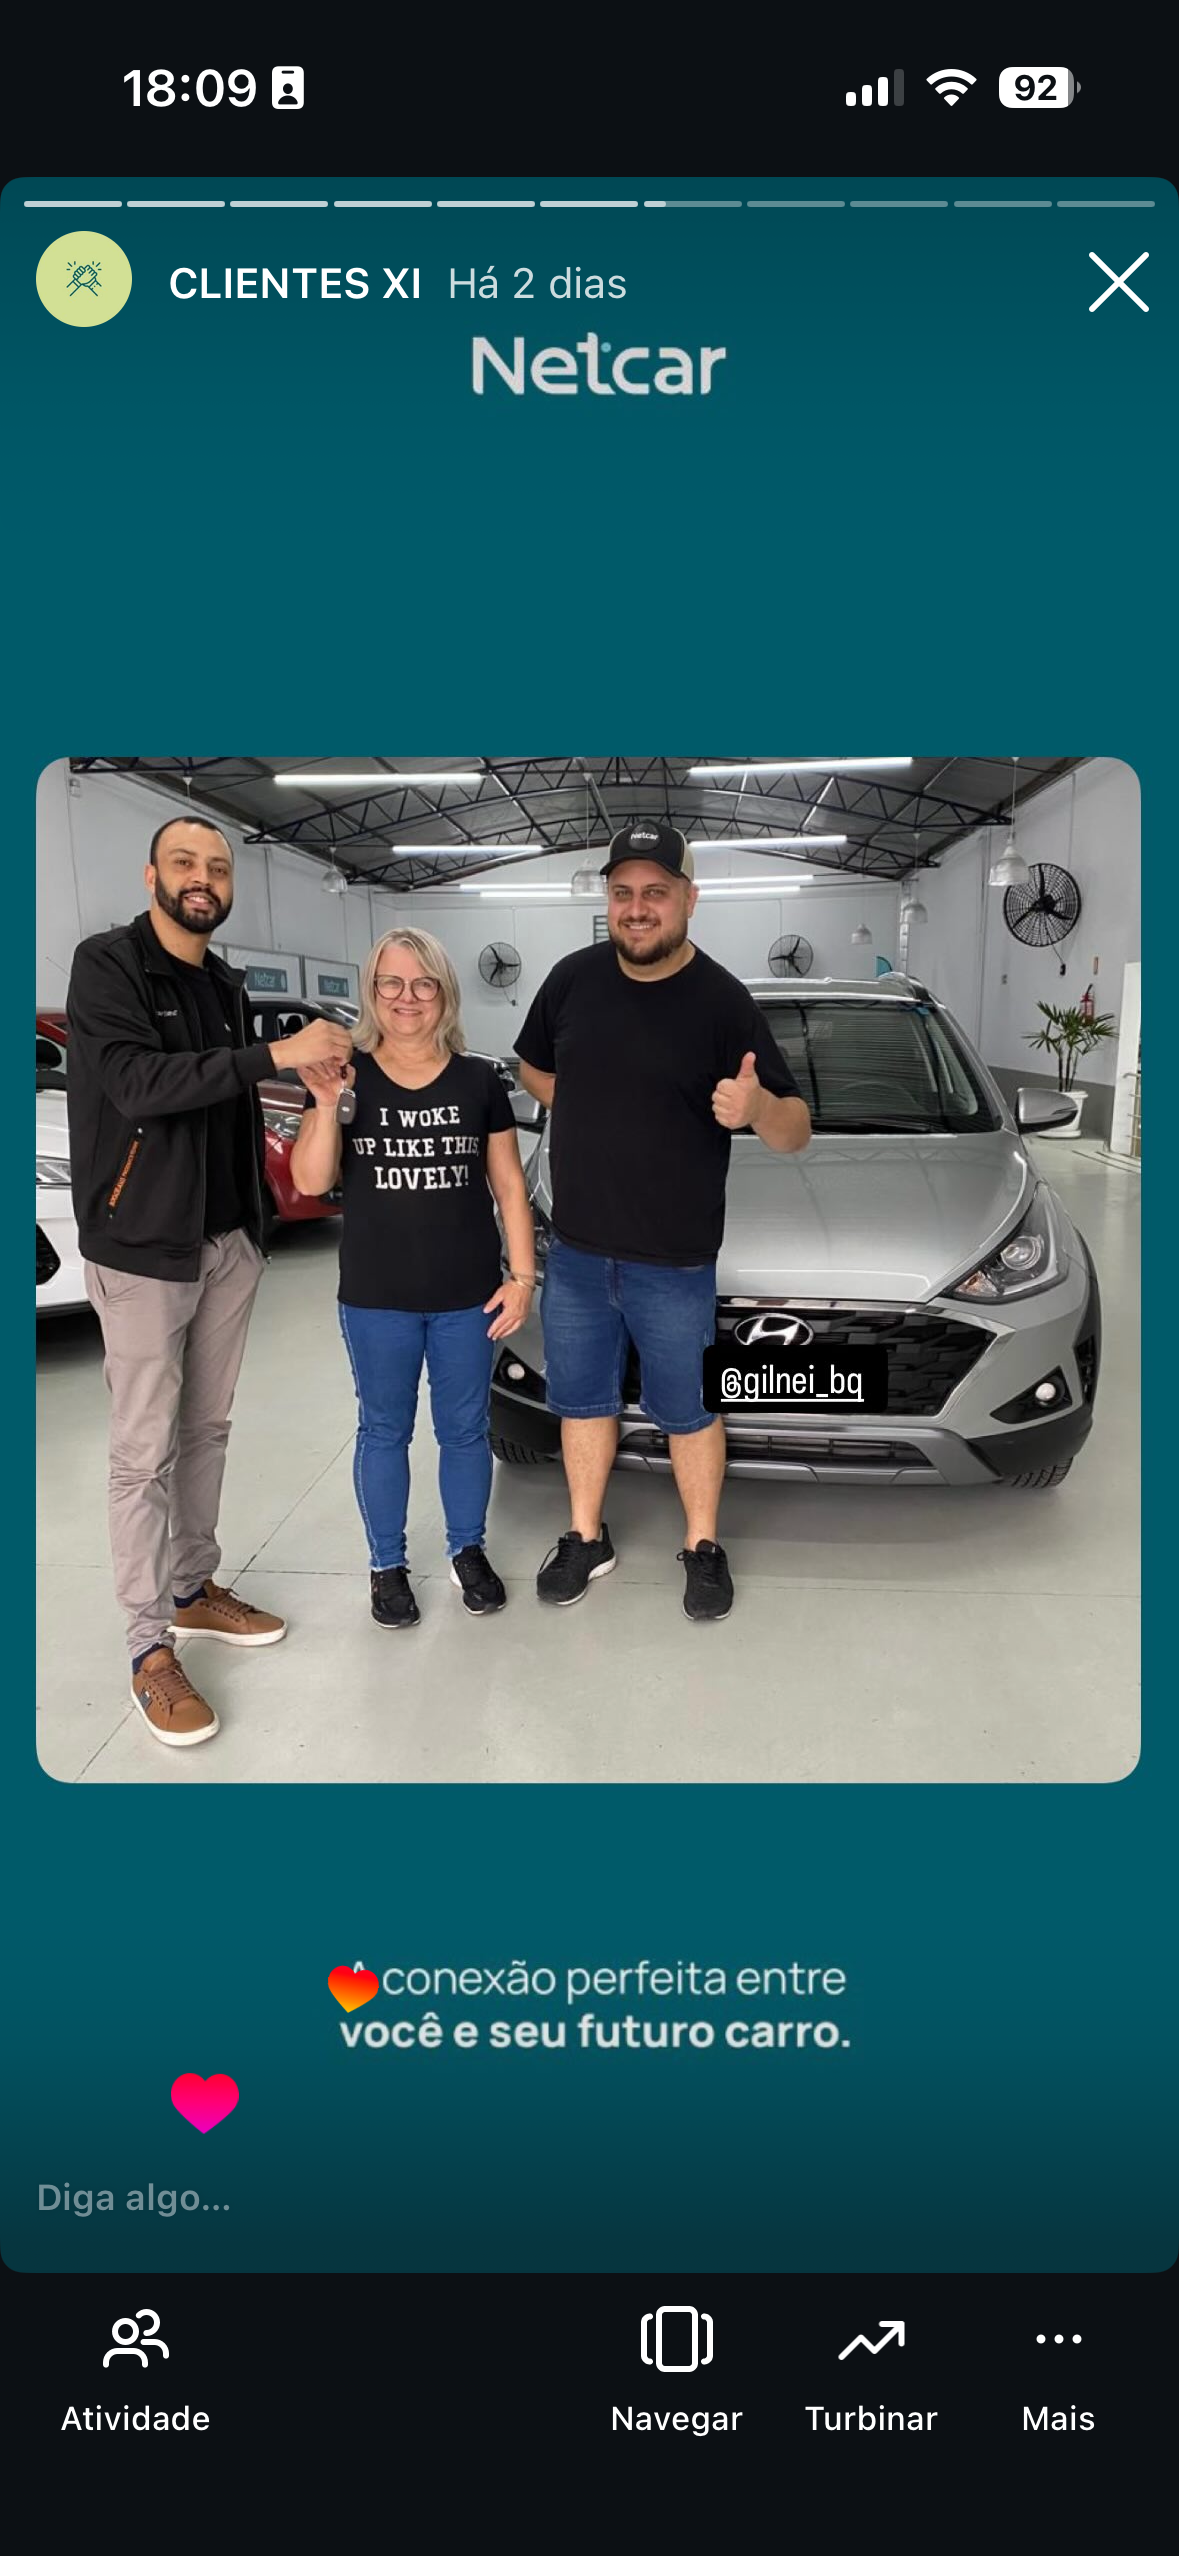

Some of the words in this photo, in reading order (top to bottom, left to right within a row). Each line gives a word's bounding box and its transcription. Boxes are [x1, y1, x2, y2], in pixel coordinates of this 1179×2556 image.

[379, 1107, 389, 1126] I
[397, 1105, 461, 1128] WOKE
[352, 1137, 377, 1156] UP
[383, 1137, 435, 1158] LIKE
[373, 1164, 469, 1190] LOVELY!
